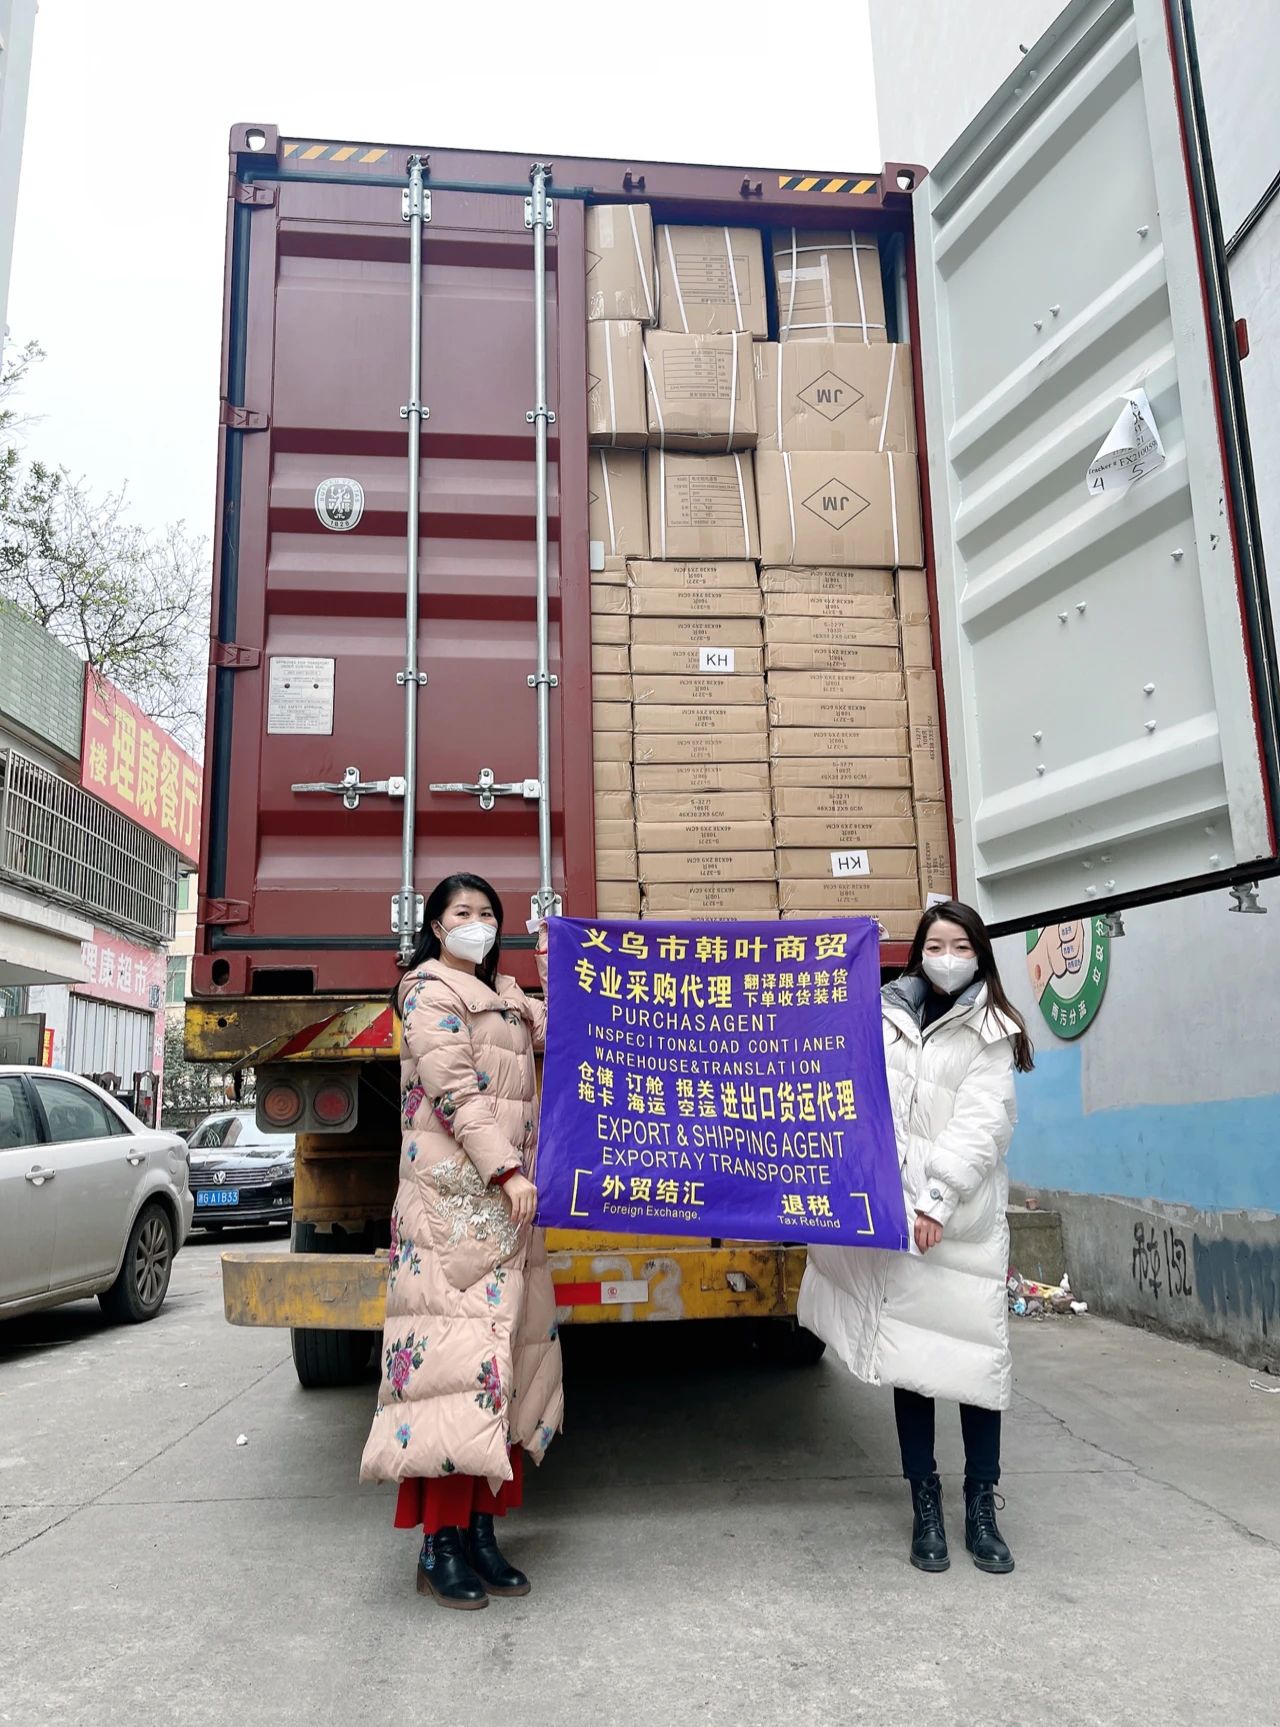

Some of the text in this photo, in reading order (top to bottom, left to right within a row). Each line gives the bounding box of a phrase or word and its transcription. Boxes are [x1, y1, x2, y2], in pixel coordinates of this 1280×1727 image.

[817, 390, 843, 403] JM
[823, 497, 849, 510] JM
[706, 654, 728, 667] KH
[838, 856, 861, 870] KH
[581, 928, 848, 963] 义乌市韩叶商贸
[575, 958, 732, 1009] 专业采购代理
[743, 970, 848, 992] 翻译跟单验货
[742, 989, 848, 1008] 下单收货装柜
[749, 1035, 846, 1054] CONTIANER
[595, 1046, 821, 1074] WAREHOUSE&TRANSLATION
[578, 1061, 858, 1123] 仓储 订舱 报关 进出口货运代理
[578, 1082, 718, 1118] 拖卡 海运 空运
[597, 1114, 844, 1159] EXPORT & SHIPPING AGENT
[709, 1152, 831, 1184] TRANSPORTE
[601, 1175, 705, 1206] 外贸结汇
[603, 1202, 643, 1217] Foreign
[781, 1194, 833, 1216] 退税
[777, 1215, 841, 1229] Tax Refund
